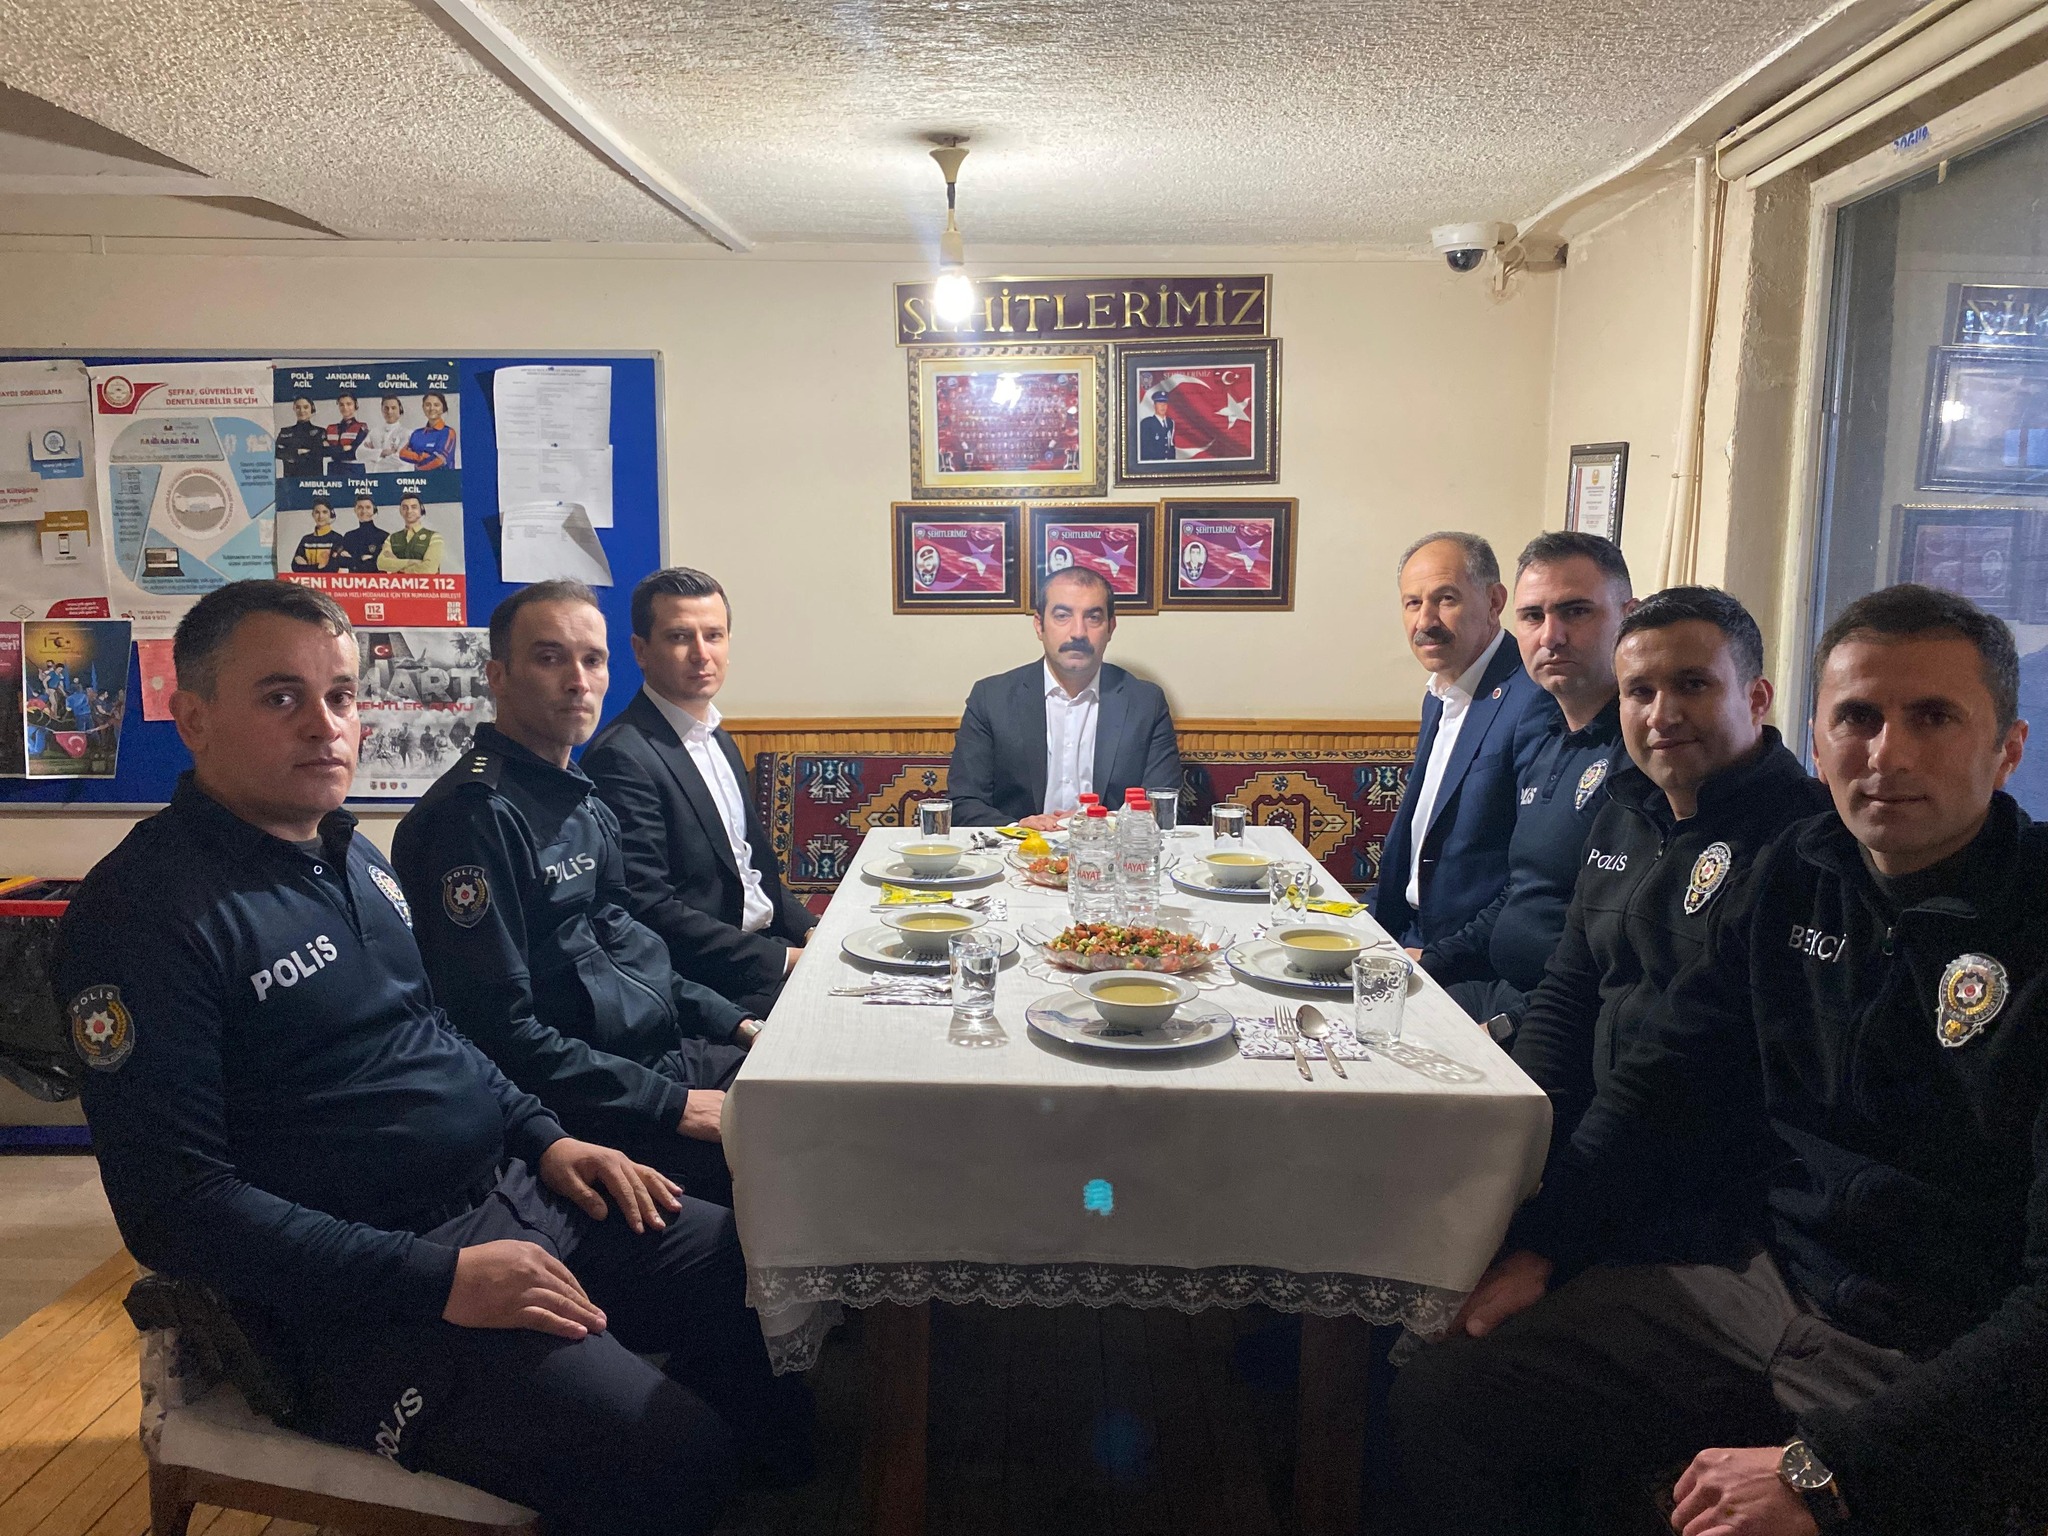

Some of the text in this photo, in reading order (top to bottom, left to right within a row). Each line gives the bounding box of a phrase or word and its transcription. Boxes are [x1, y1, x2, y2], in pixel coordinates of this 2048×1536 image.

[291, 371, 314, 380] POLİS
[325, 373, 371, 381] JANDARMA
[386, 372, 410, 381] SAHİL
[293, 379, 312, 388] ACİL
[339, 379, 358, 388] ACİL
[378, 379, 418, 389] GÜVENLİK
[429, 380, 448, 389] ACİL
[199, 388, 242, 396] GÜVENİLİR
[244, 387, 255, 395] VE
[166, 397, 258, 405] DENETLENEBİLİR SEÇİM
[347, 478, 379, 487] İTFAİYE
[396, 478, 427, 486] ORMAN
[312, 487, 330, 496] ACİL
[354, 486, 373, 495] ACİL
[402, 484, 421, 494] ACİL
[927, 529, 967, 539] ŞEHİTLERİMİZ
[1061, 529, 1101, 539] ŞEHİTLERİMİZ
[1195, 525, 1236, 535] ŞEHİTLERİMİZ
[331, 577, 429, 590] NUMARAMIZ
[433, 578, 455, 590] 112
[367, 605, 381, 613] 112
[1587, 848, 1627, 872] POLİS
[1123, 862, 1147, 872] HAYAT
[1077, 870, 1101, 880] HAYAT
[250, 934, 338, 1002] POLİS
